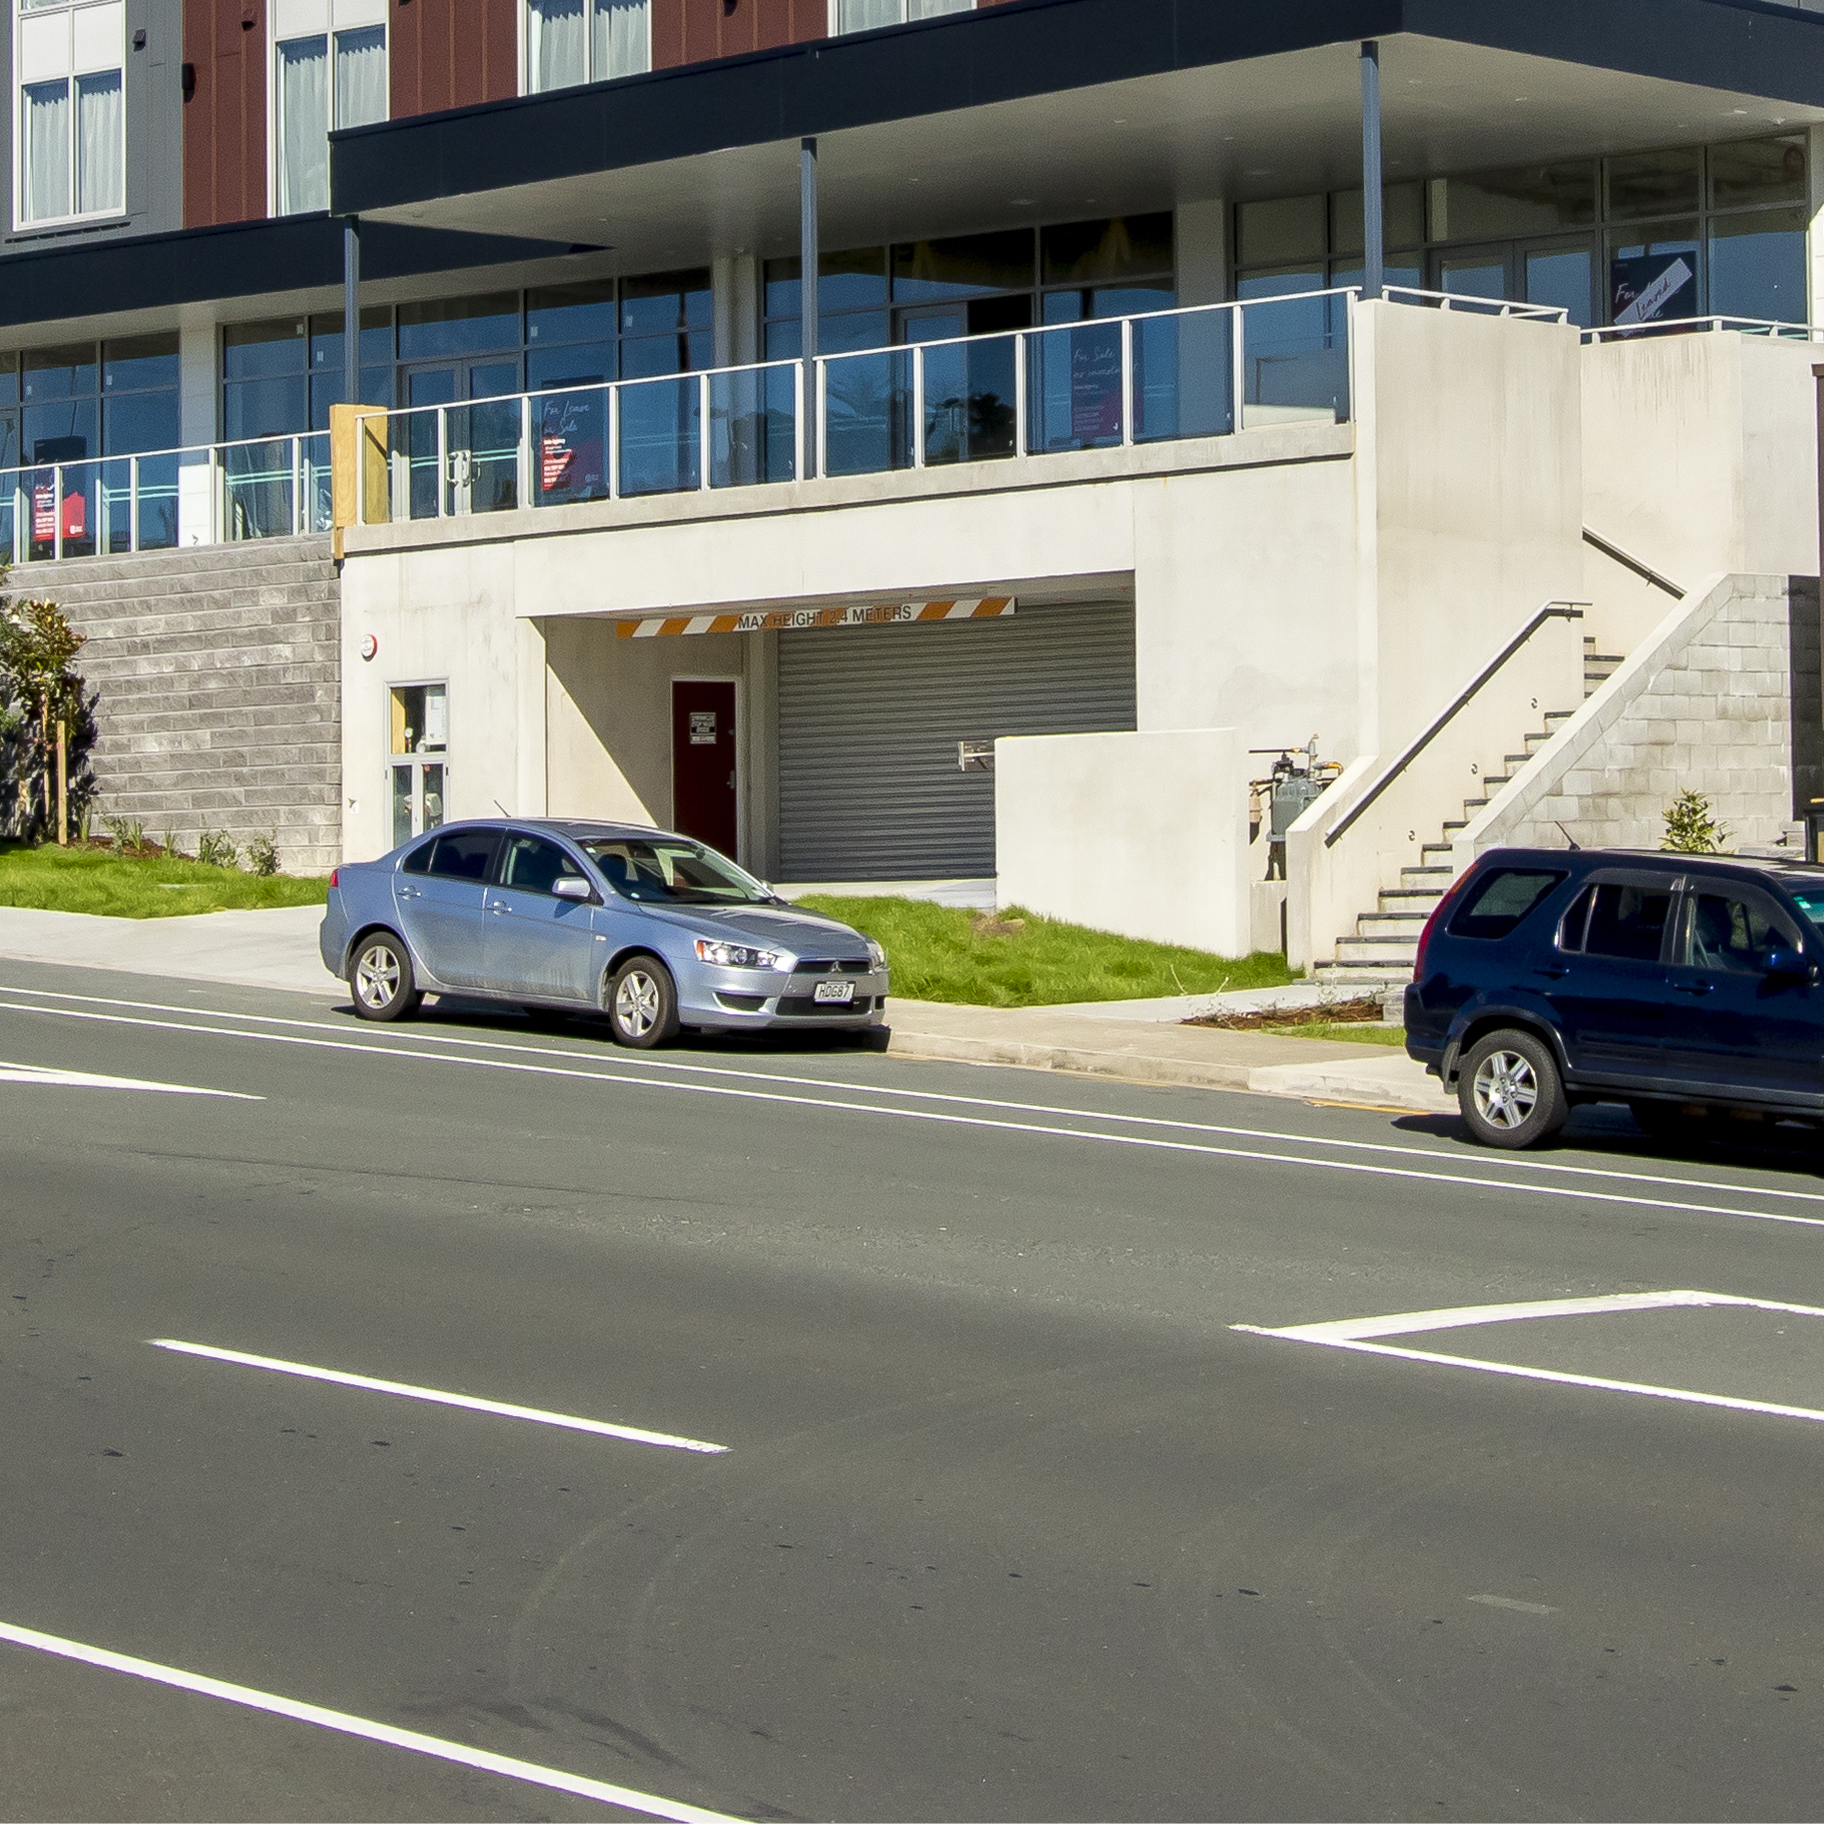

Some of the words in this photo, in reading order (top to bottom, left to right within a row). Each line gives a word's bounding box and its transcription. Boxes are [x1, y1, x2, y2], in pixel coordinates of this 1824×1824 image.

[738, 615, 768, 629] MAX
[773, 611, 824, 627] HEIGHT
[829, 609, 848, 624] 2.4
[852, 605, 912, 623] METERS
